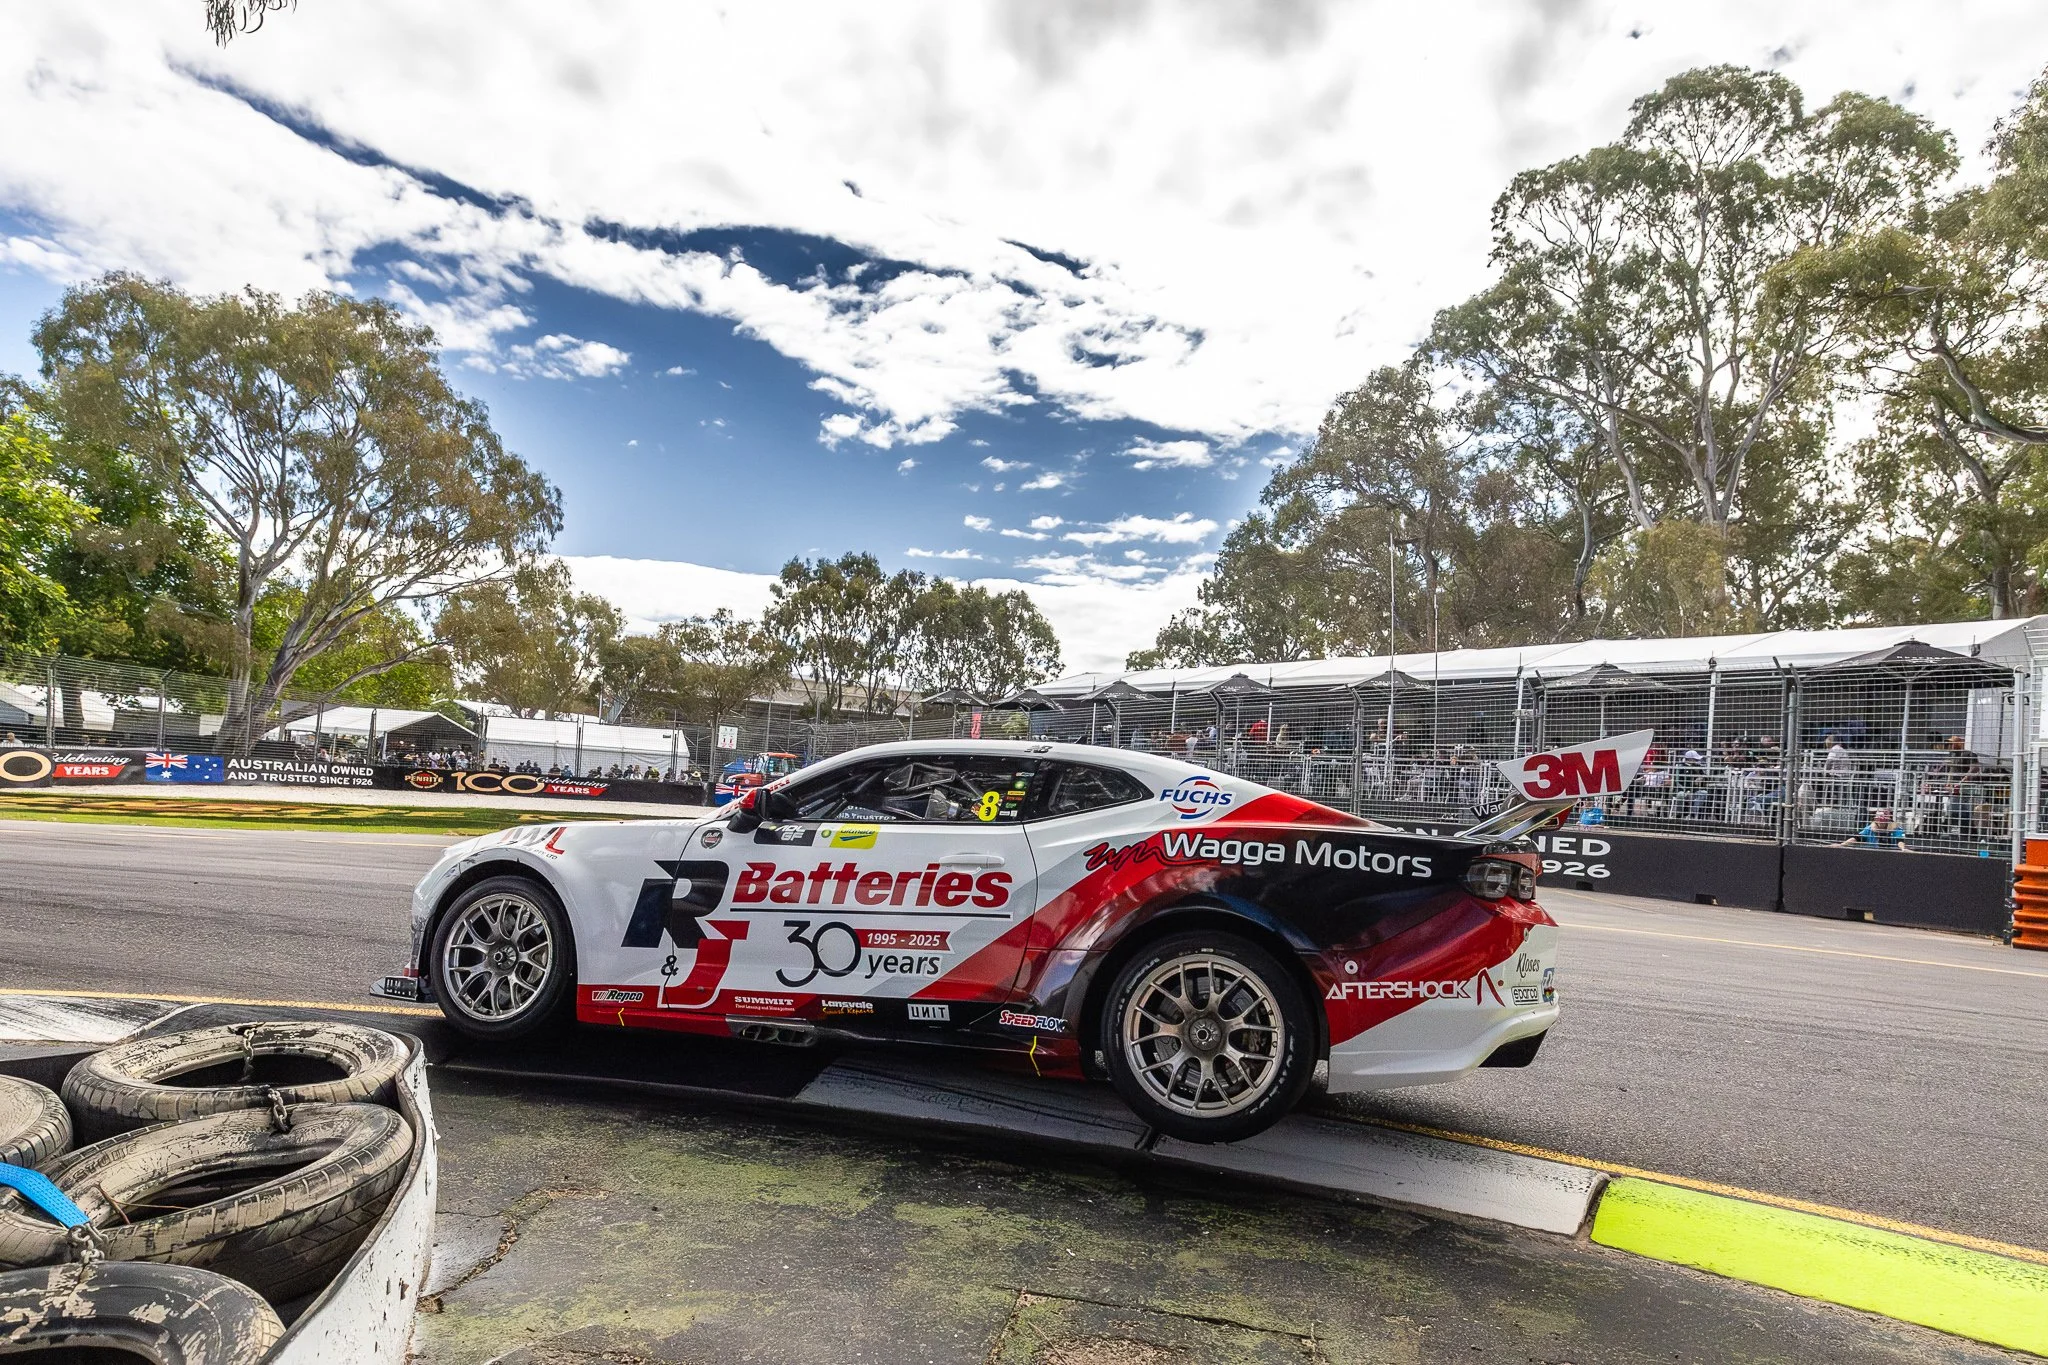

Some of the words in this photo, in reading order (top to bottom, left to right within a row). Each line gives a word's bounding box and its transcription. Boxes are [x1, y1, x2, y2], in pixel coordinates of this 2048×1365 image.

[64, 766, 109, 776] YEARS
[227, 758, 328, 774] AUSTRALIAN
[331, 766, 374, 777] OWNED
[1523, 749, 1622, 799] 3M
[227, 772, 258, 781] AND
[261, 772, 317, 783] TRUSTED
[320, 775, 350, 785] SINCE
[352, 777, 374, 786] 1926
[404, 775, 444, 783] PENRITE
[536, 776, 610, 788] Celebrating
[552, 786, 590, 794] YEARS
[1159, 787, 1233, 806] FUCHS
[978, 790, 1000, 822] 8
[774, 824, 806, 833] ADL
[1164, 833, 1286, 866] Wagga
[1294, 839, 1432, 878] Motors
[1541, 859, 1612, 878] 926
[731, 862, 1013, 908] Batteries
[621, 860, 730, 949] R
[866, 932, 898, 947] 1995
[908, 933, 941, 947] 2025
[775, 920, 862, 988] 30
[660, 920, 750, 1009] J
[661, 955, 679, 976] &
[864, 952, 941, 979] years
[605, 988, 644, 1003] Repco
[1325, 980, 1472, 1000] AFTERSHOCK
[1513, 987, 1539, 1000] sparco
[734, 996, 794, 1006] SUMMIT
[821, 999, 874, 1009] Lansvale
[911, 1005, 948, 1020] UNIT
[1000, 1010, 1068, 1032] SPEEDFLOW
